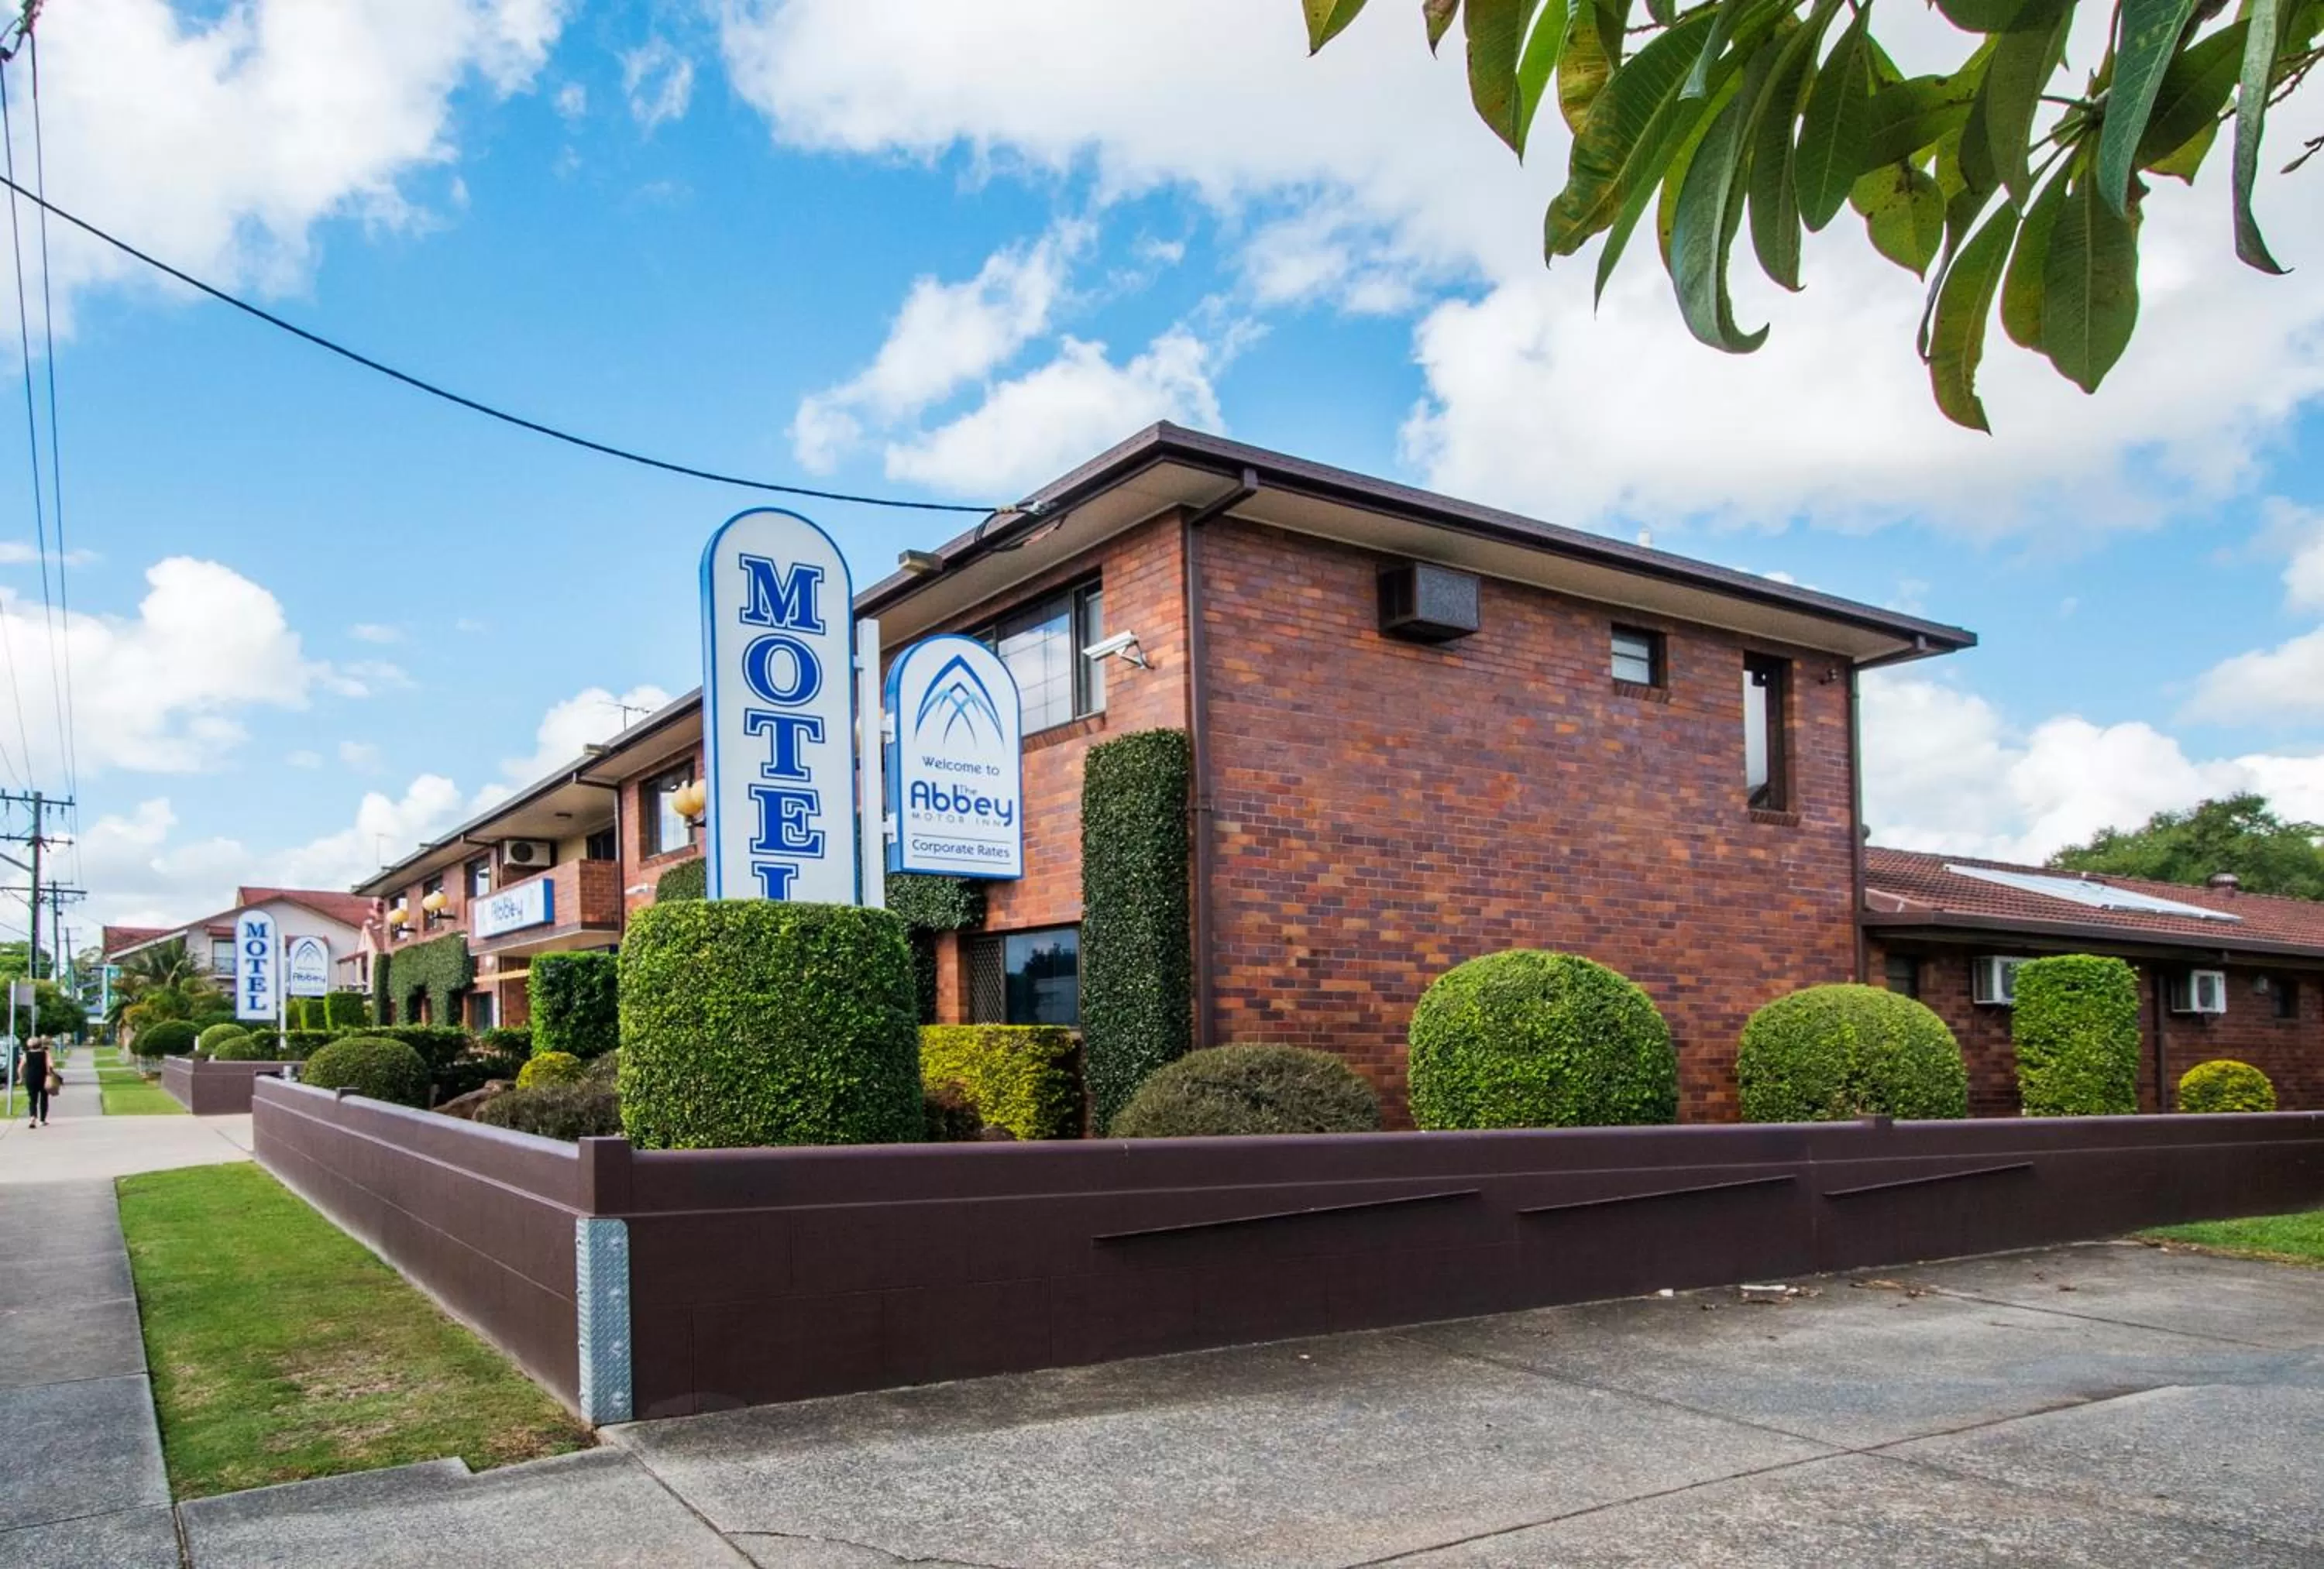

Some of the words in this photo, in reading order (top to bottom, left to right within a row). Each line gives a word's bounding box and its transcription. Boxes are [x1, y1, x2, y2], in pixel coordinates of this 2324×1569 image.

[922, 755, 982, 775] Welcome
[985, 764, 1000, 776] to
[959, 784, 978, 795] The
[910, 780, 1013, 828] Abbey
[911, 812, 964, 824] MOTOR
[975, 817, 1002, 827] INN
[912, 839, 975, 855] Corporate
[978, 845, 1011, 859] Rates
[244, 922, 268, 1011] MOTEL
[293, 971, 326, 984] Abbey
